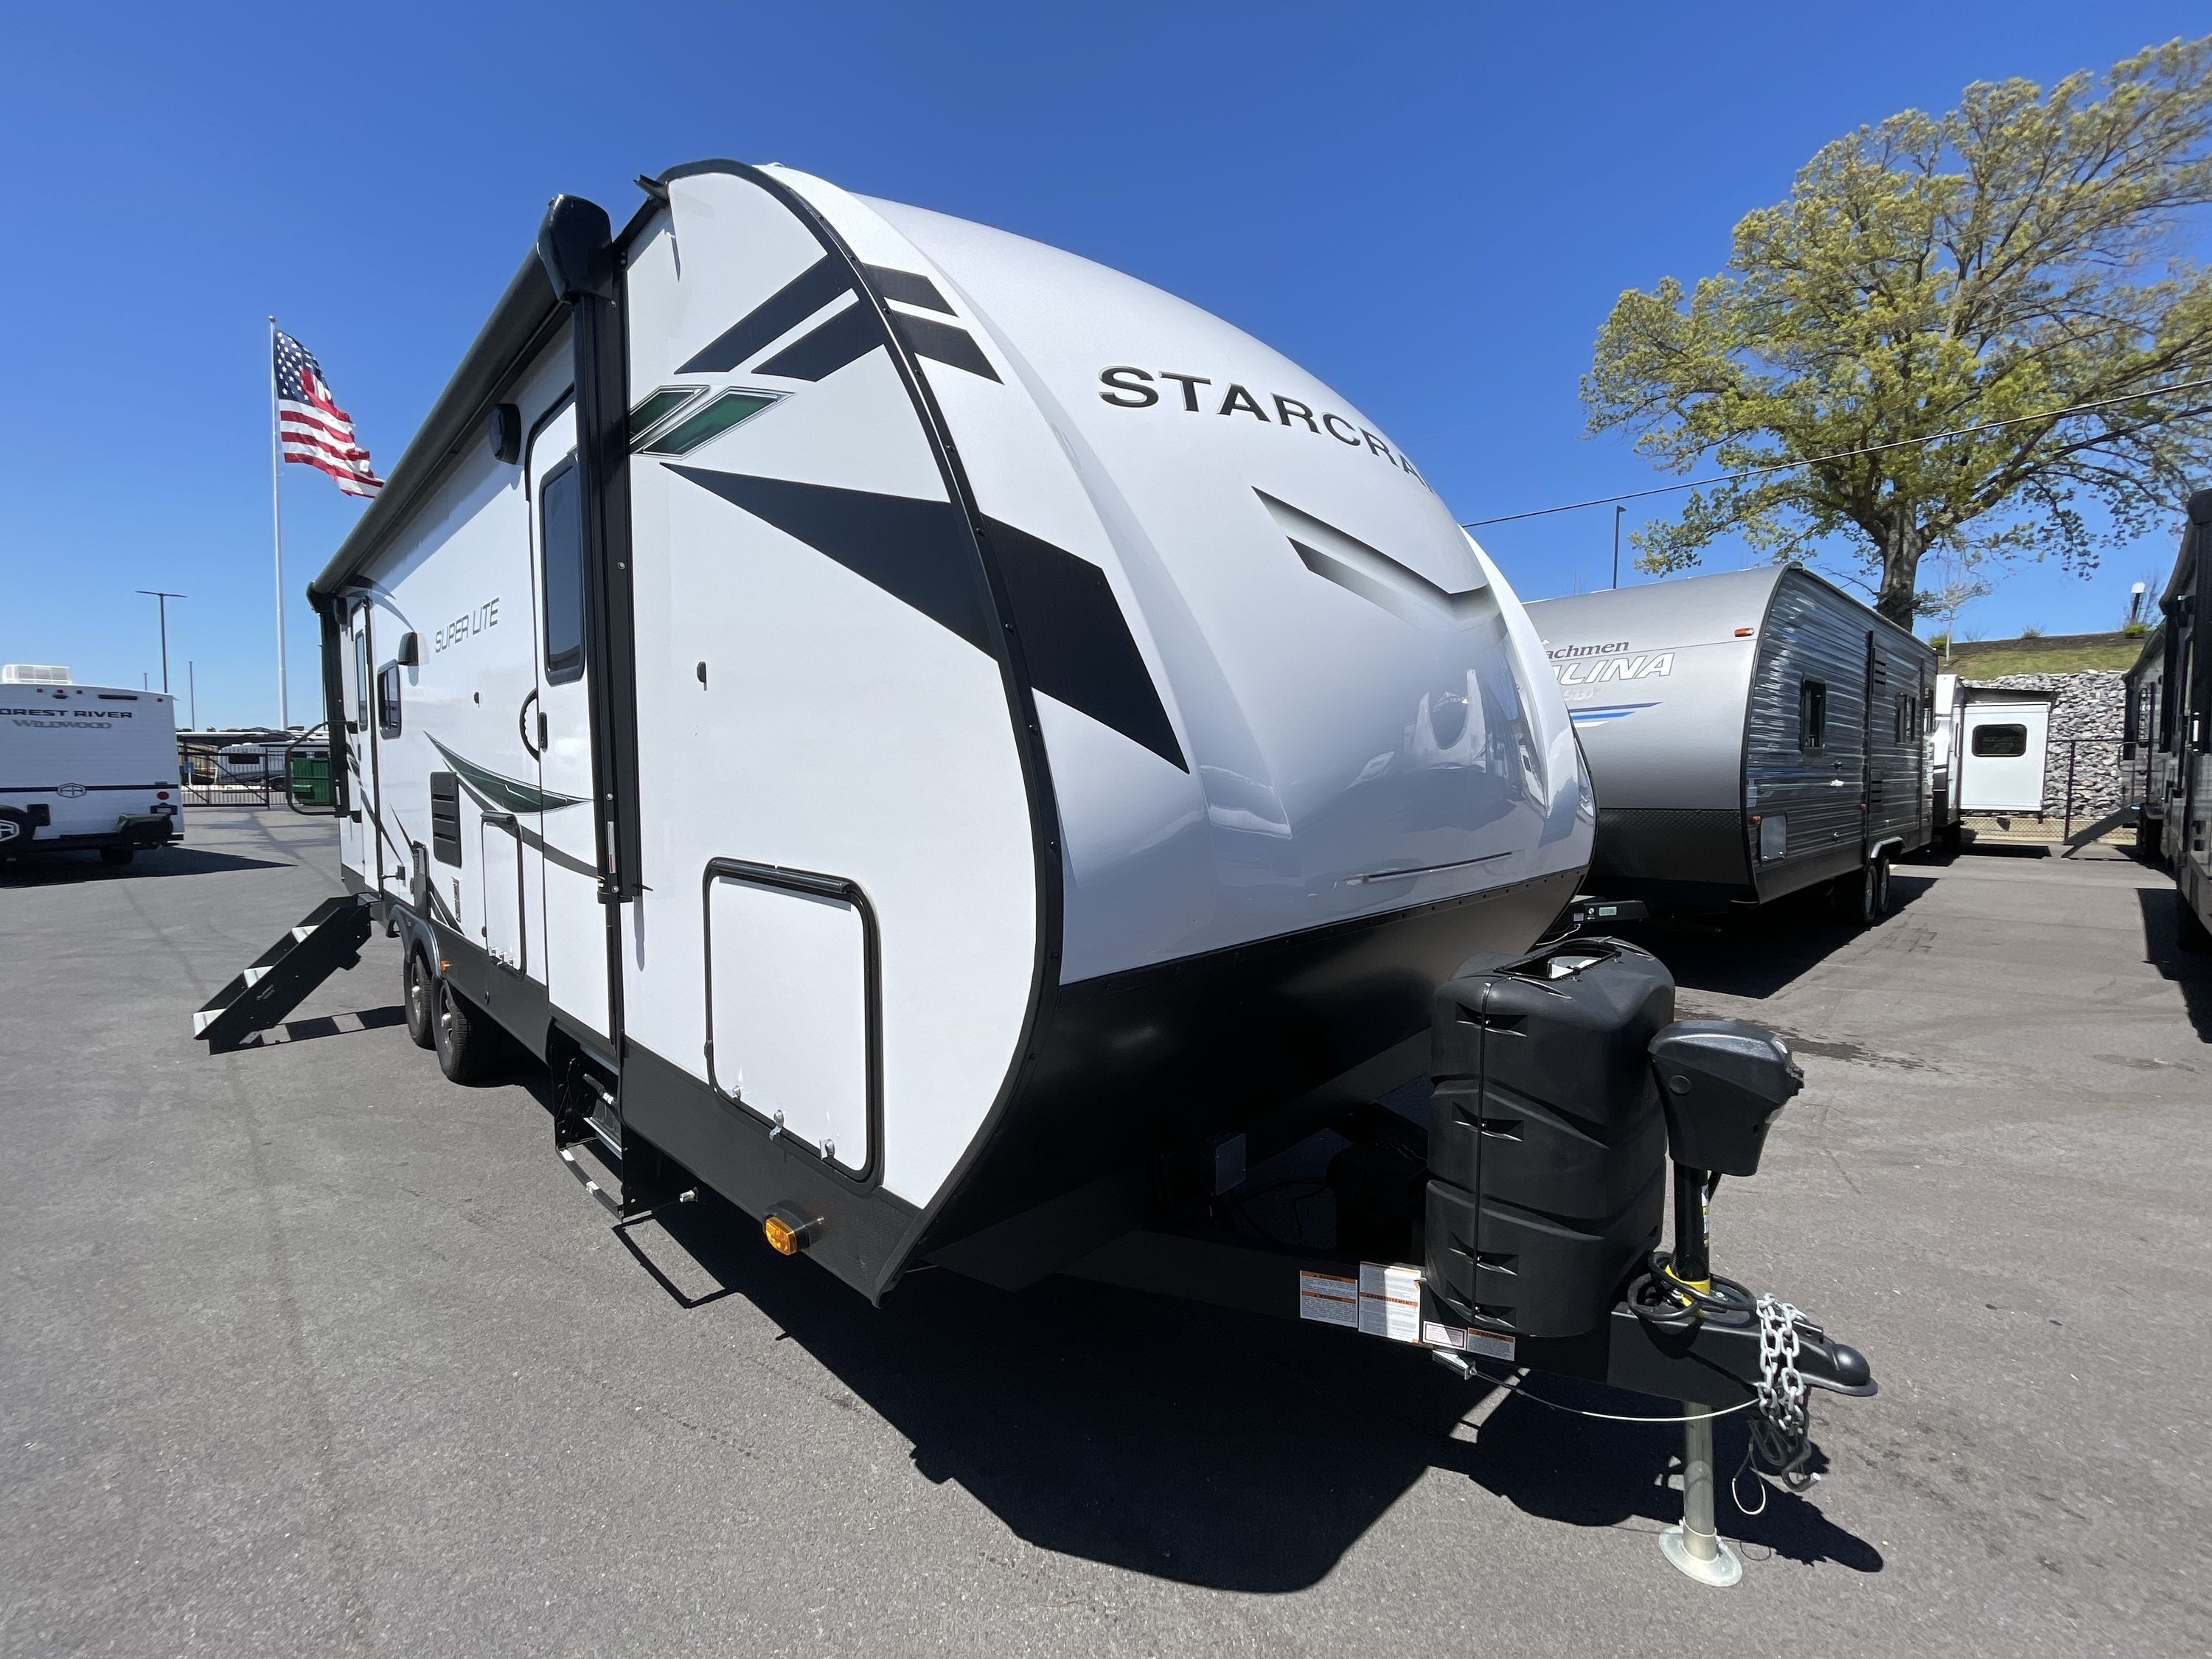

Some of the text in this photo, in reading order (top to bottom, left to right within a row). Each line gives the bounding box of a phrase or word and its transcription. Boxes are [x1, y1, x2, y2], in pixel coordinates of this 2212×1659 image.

[1098, 365, 1434, 495] STARCRA
[436, 597, 499, 653] SUPER LITE
[12, 720, 112, 729] WILDWOOD
[74, 710, 132, 718] RIVER
